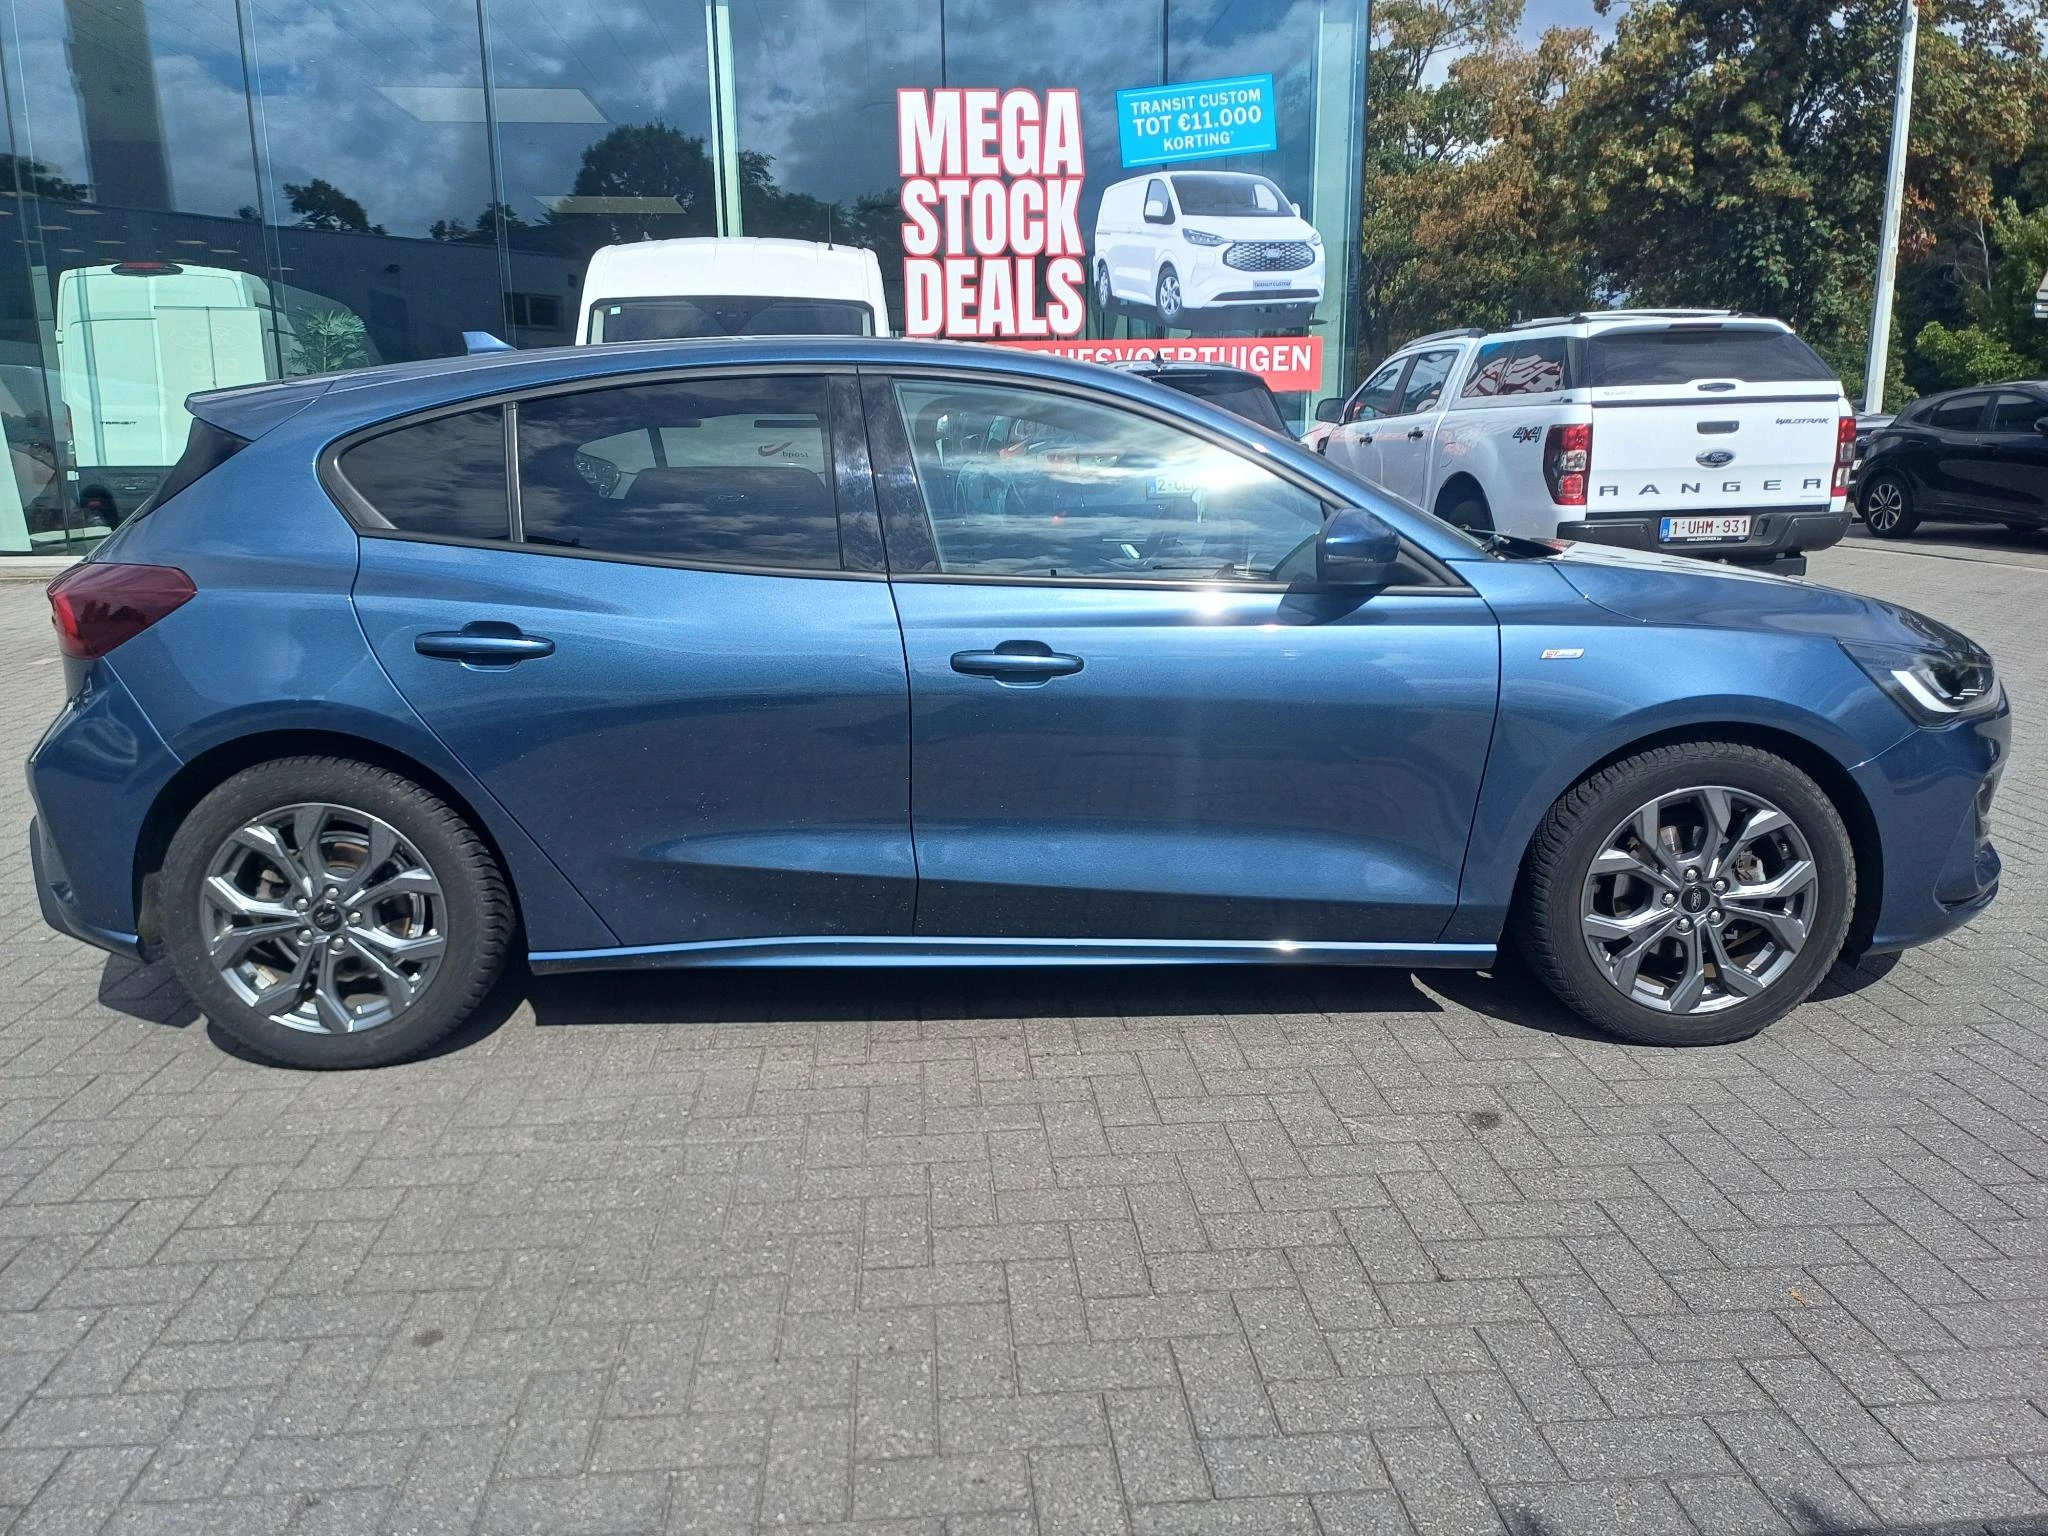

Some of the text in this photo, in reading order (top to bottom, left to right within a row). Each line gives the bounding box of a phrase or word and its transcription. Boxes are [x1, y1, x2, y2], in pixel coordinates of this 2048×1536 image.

[1130, 88, 1261, 115] TRANSIT CUSTOM
[898, 89, 1084, 175] MEGA
[1133, 105, 1262, 136] TOT €11.000
[902, 177, 1084, 256] STOCK
[905, 257, 1085, 337] DEALS
[1776, 417, 1830, 425] WILDTRAK
[1599, 478, 1822, 497] RANGER
[1672, 519, 1747, 535] 1-UHM-931
